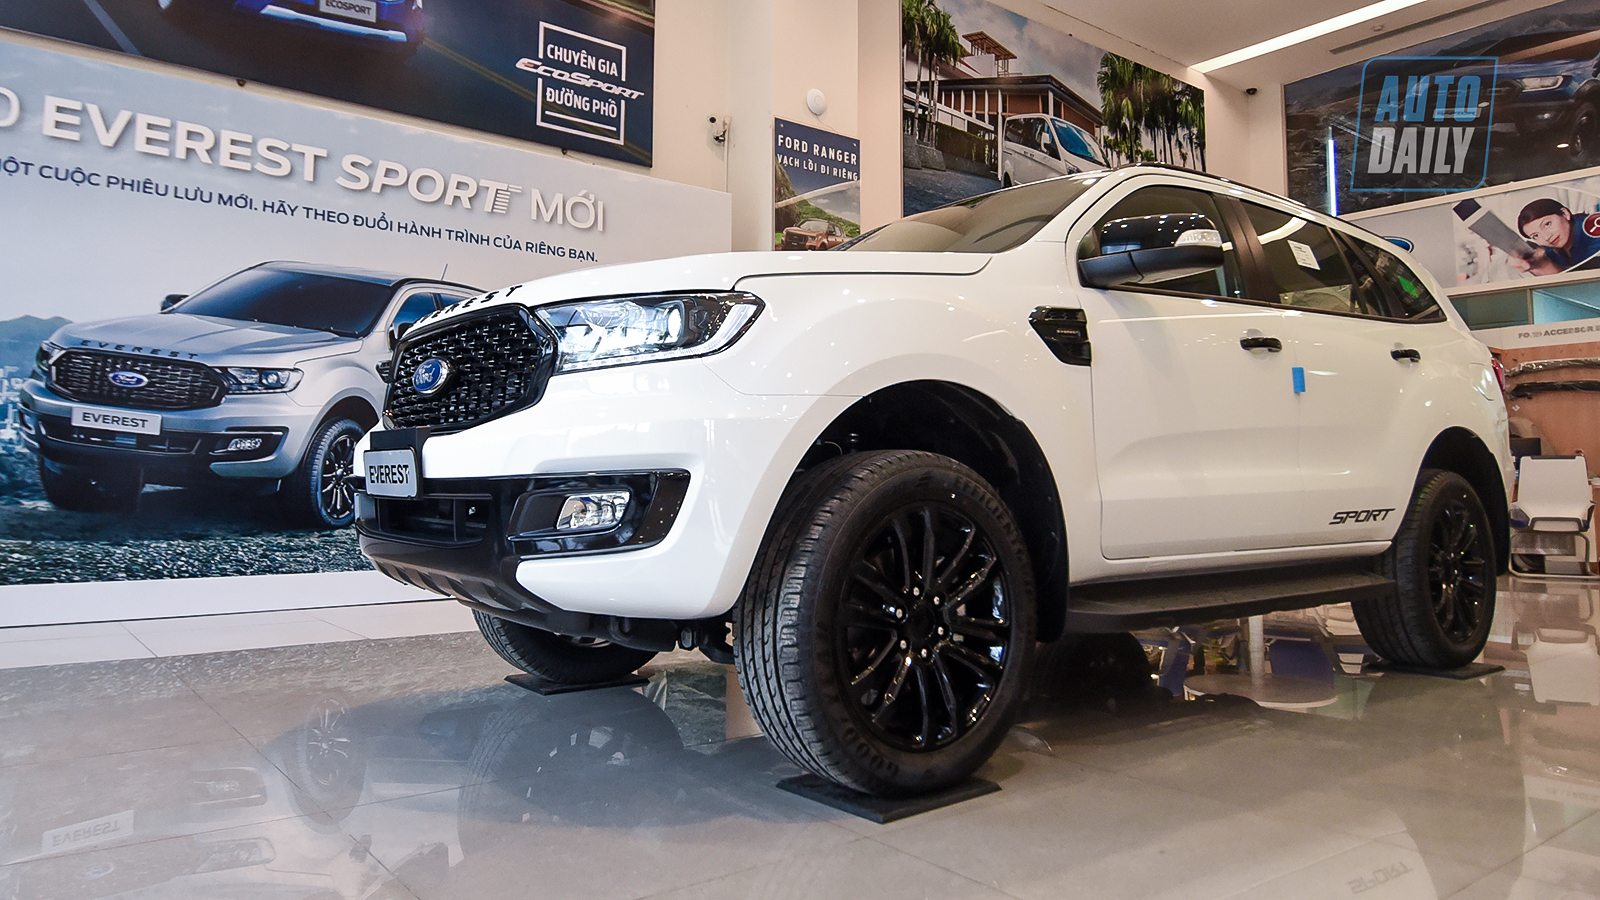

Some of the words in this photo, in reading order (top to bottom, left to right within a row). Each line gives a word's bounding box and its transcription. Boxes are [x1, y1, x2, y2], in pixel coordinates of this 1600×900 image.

[546, 43, 596, 71] CHUYÊN
[597, 58, 619, 77] GIA
[546, 87, 590, 112] ĐƯỜNG
[592, 98, 618, 118] PHỐ
[42, 94, 328, 183] EVEREST
[335, 153, 523, 214] SPORT
[530, 189, 604, 232] MỚI
[777, 134, 808, 153] FORD
[813, 143, 857, 166] RANGER
[777, 153, 800, 167] VẠCH
[833, 167, 858, 181] RIÊNG
[38, 165, 101, 187] CUỘC
[106, 175, 169, 197] PHIÊU
[173, 185, 213, 204] LƯU
[218, 192, 258, 211] MỚI.
[262, 199, 299, 217] HÃY
[302, 206, 349, 225] THEO
[353, 211, 393, 232] ĐUỔI
[397, 220, 442, 239] HÀNH
[445, 228, 490, 246] TRÌNH
[493, 234, 522, 251] CỦA
[525, 241, 566, 258] RIÊNG
[569, 249, 598, 263] BẠN.
[80, 339, 199, 359] EVEREST
[82, 411, 149, 428] EVEREST
[369, 463, 410, 485] EVEREST
[1328, 507, 1396, 525] SPORT
